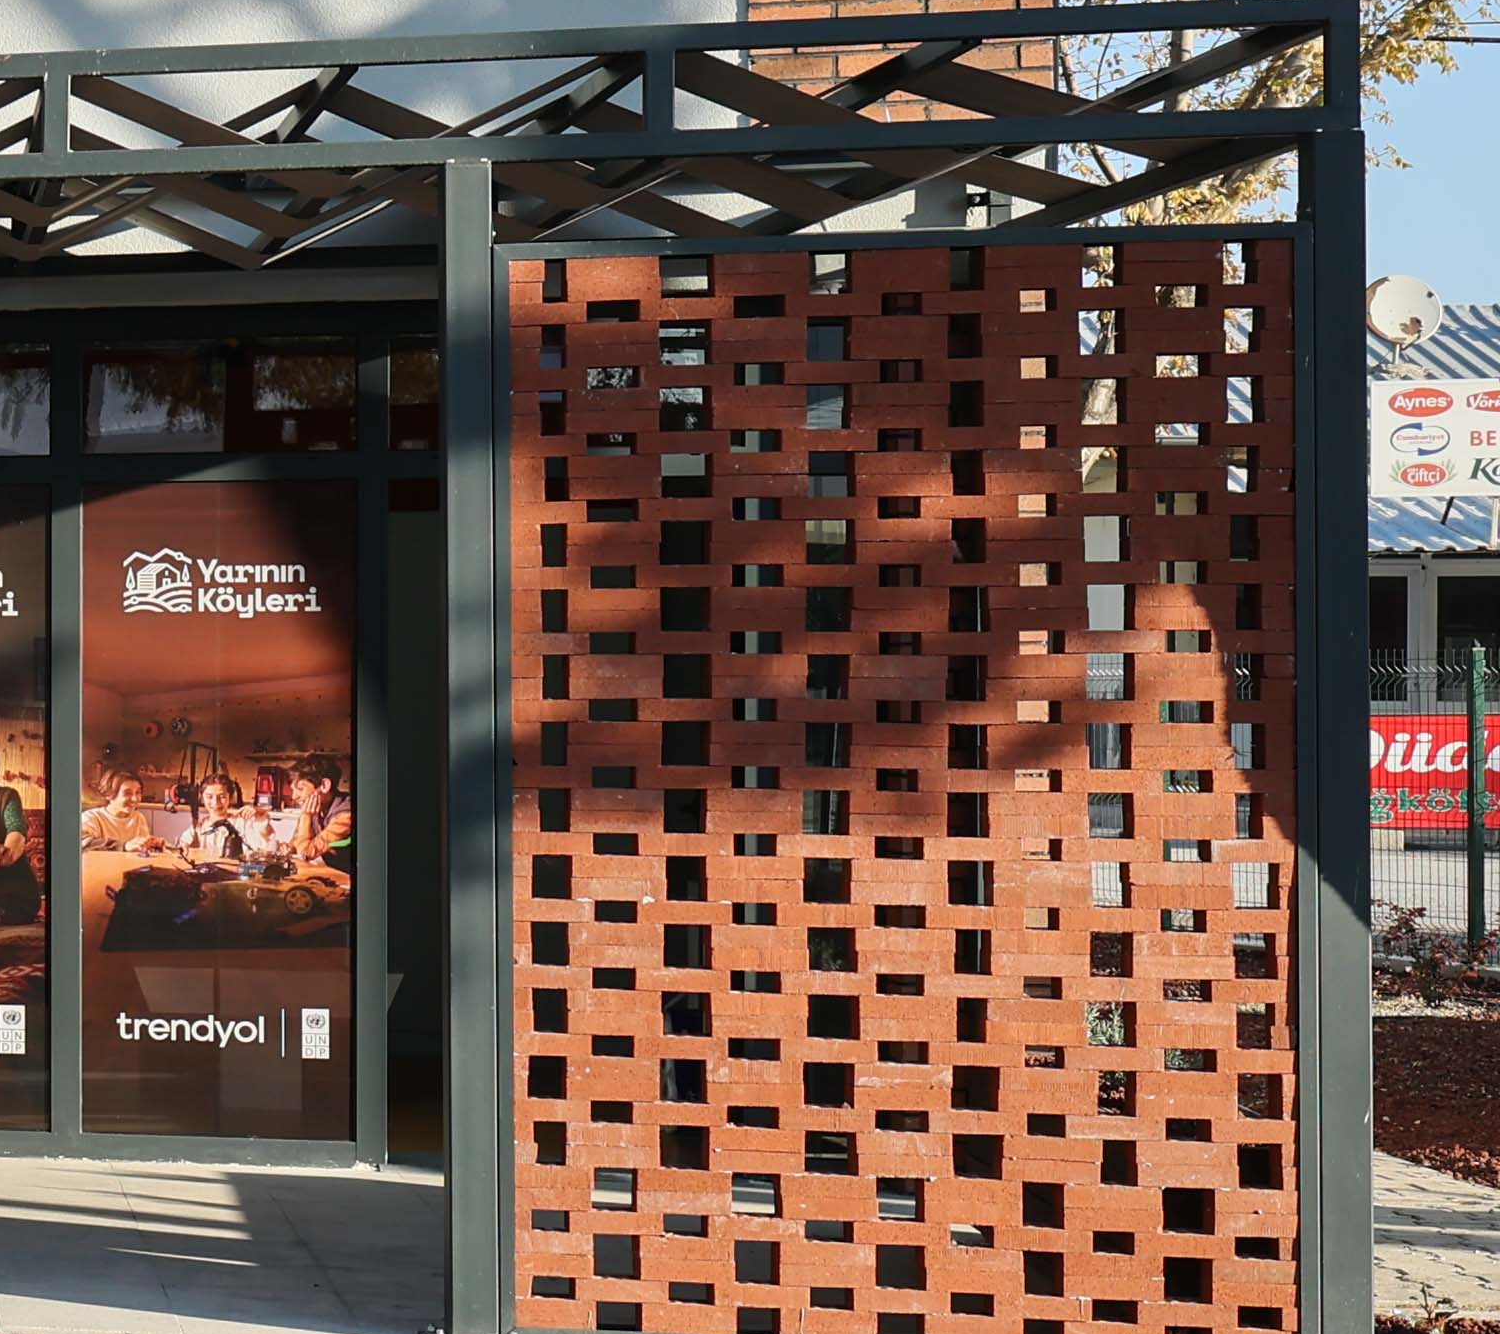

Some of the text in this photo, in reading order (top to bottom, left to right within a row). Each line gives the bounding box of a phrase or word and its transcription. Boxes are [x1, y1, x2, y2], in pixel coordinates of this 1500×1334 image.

[1394, 395, 1448, 411] Aynes
[196, 558, 305, 583] Yarının
[198, 586, 322, 619] Köyleri
[116, 1012, 265, 1048] trendyol
